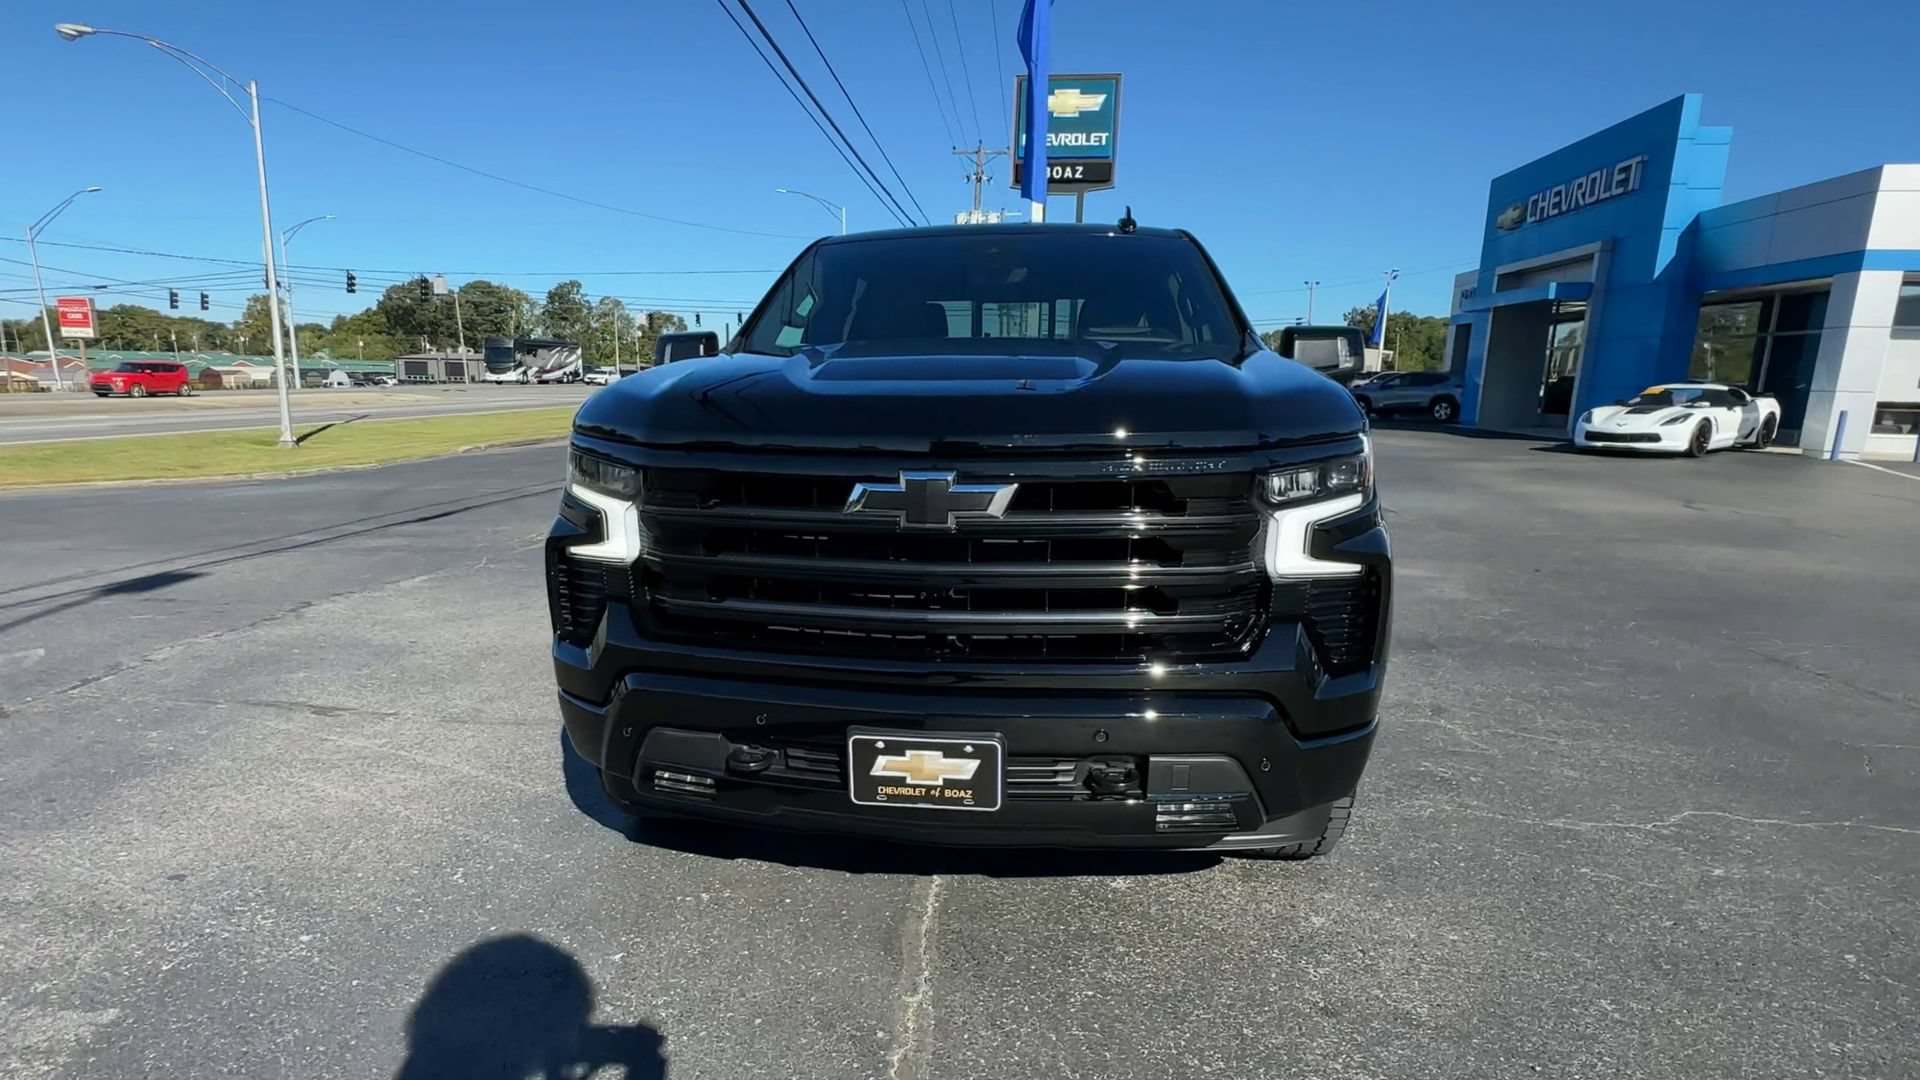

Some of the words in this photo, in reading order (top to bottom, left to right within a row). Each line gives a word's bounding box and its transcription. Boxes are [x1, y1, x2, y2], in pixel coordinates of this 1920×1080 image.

[1023, 133, 1109, 146] EVROLET
[1527, 155, 1648, 223] CHEVROLET
[878, 786, 926, 796] CHEVROLET
[930, 787, 941, 798] of
[944, 789, 973, 798] BOAZ
